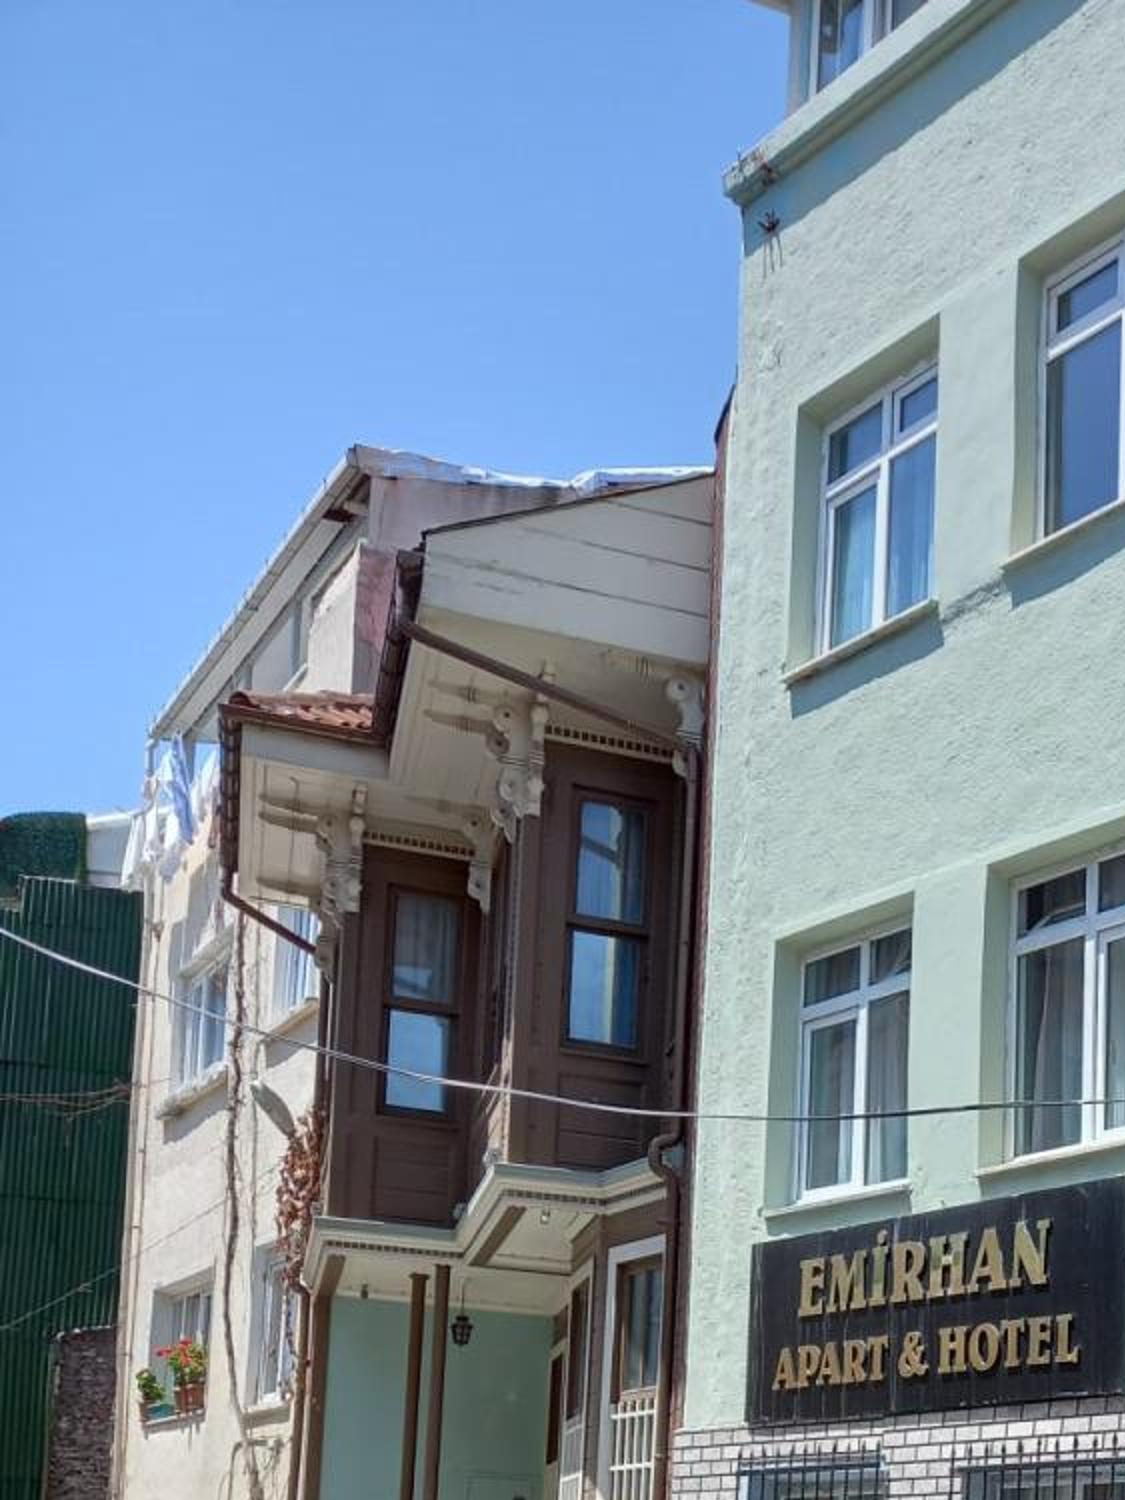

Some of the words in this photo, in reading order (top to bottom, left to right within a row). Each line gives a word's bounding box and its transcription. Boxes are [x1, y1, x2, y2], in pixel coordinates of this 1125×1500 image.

[798, 1217, 1052, 1318] EMİRHAN
[772, 1336, 888, 1391] APART
[898, 1331, 929, 1378] &
[938, 1313, 1081, 1374] HOTEL
